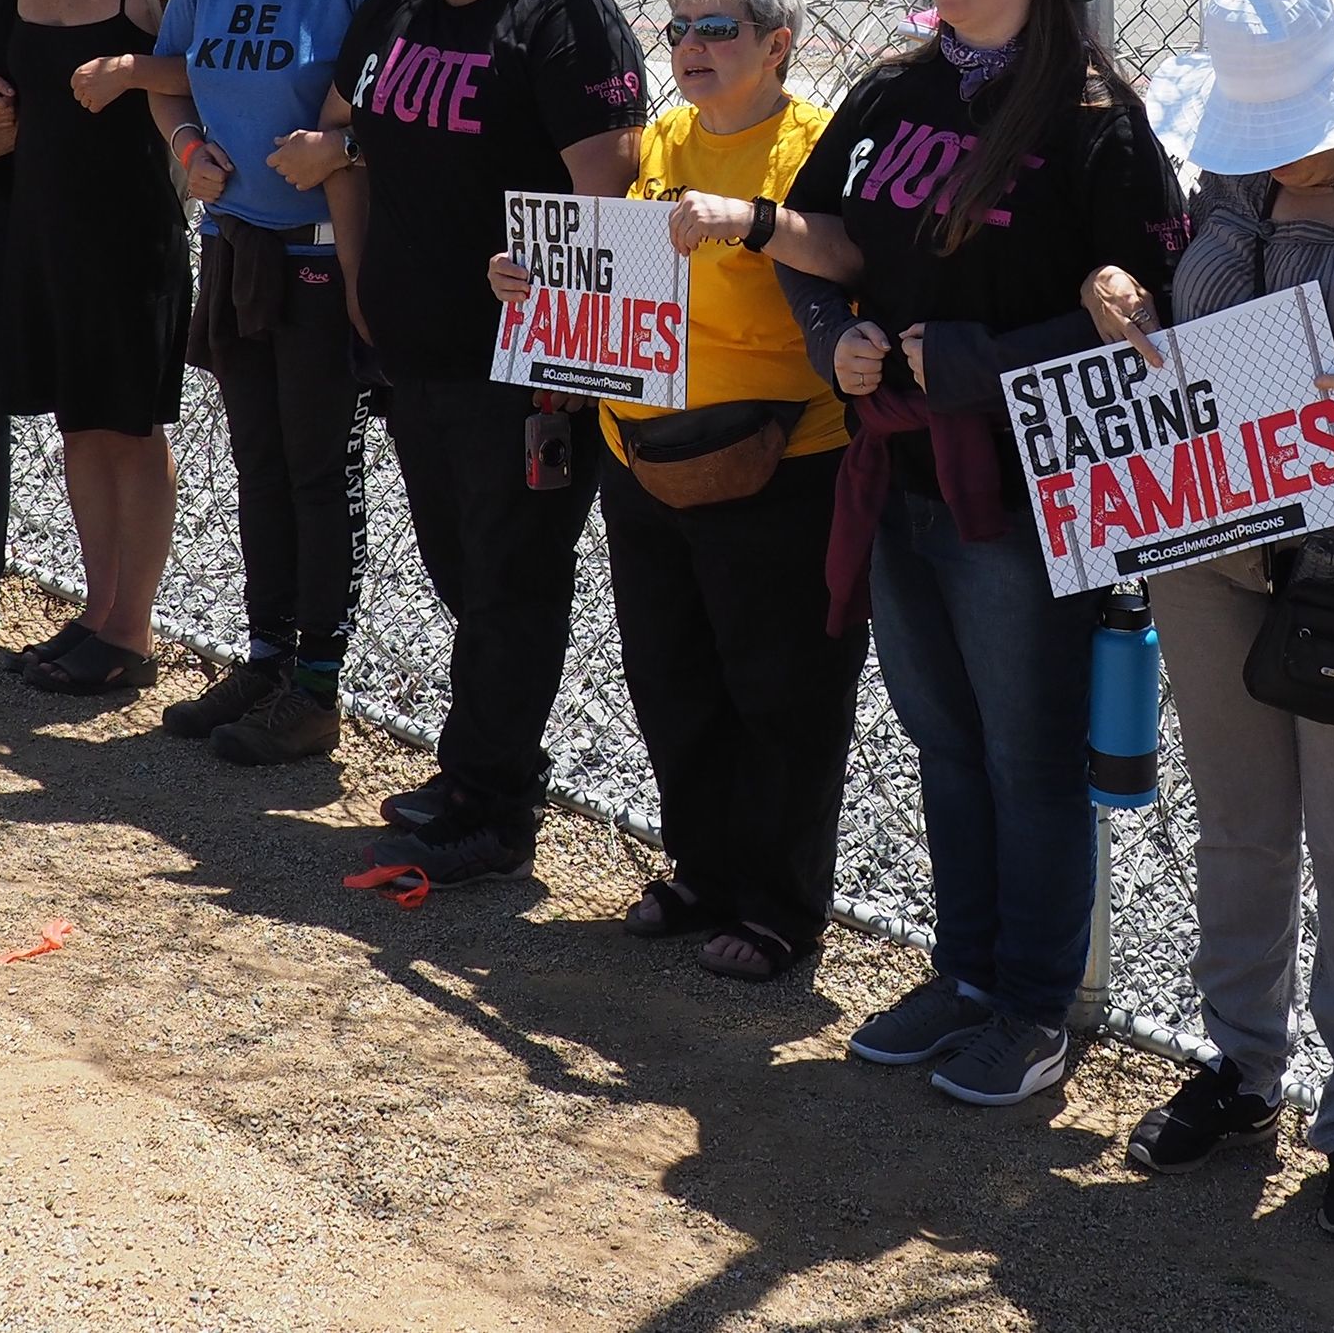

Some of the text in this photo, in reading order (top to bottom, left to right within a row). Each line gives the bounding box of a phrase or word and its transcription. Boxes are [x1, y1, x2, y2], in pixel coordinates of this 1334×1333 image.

[227, 4, 282, 35] BE
[194, 37, 295, 71] KIND
[352, 36, 492, 134] & VOTE
[509, 197, 580, 244] STOP
[512, 241, 614, 294] CAGING
[500, 288, 682, 375] FAMILIES
[1011, 346, 1149, 427] STOP
[346, 388, 372, 454] LOVE
[1023, 379, 1220, 477] CAGING
[349, 526, 369, 594] LOVE
